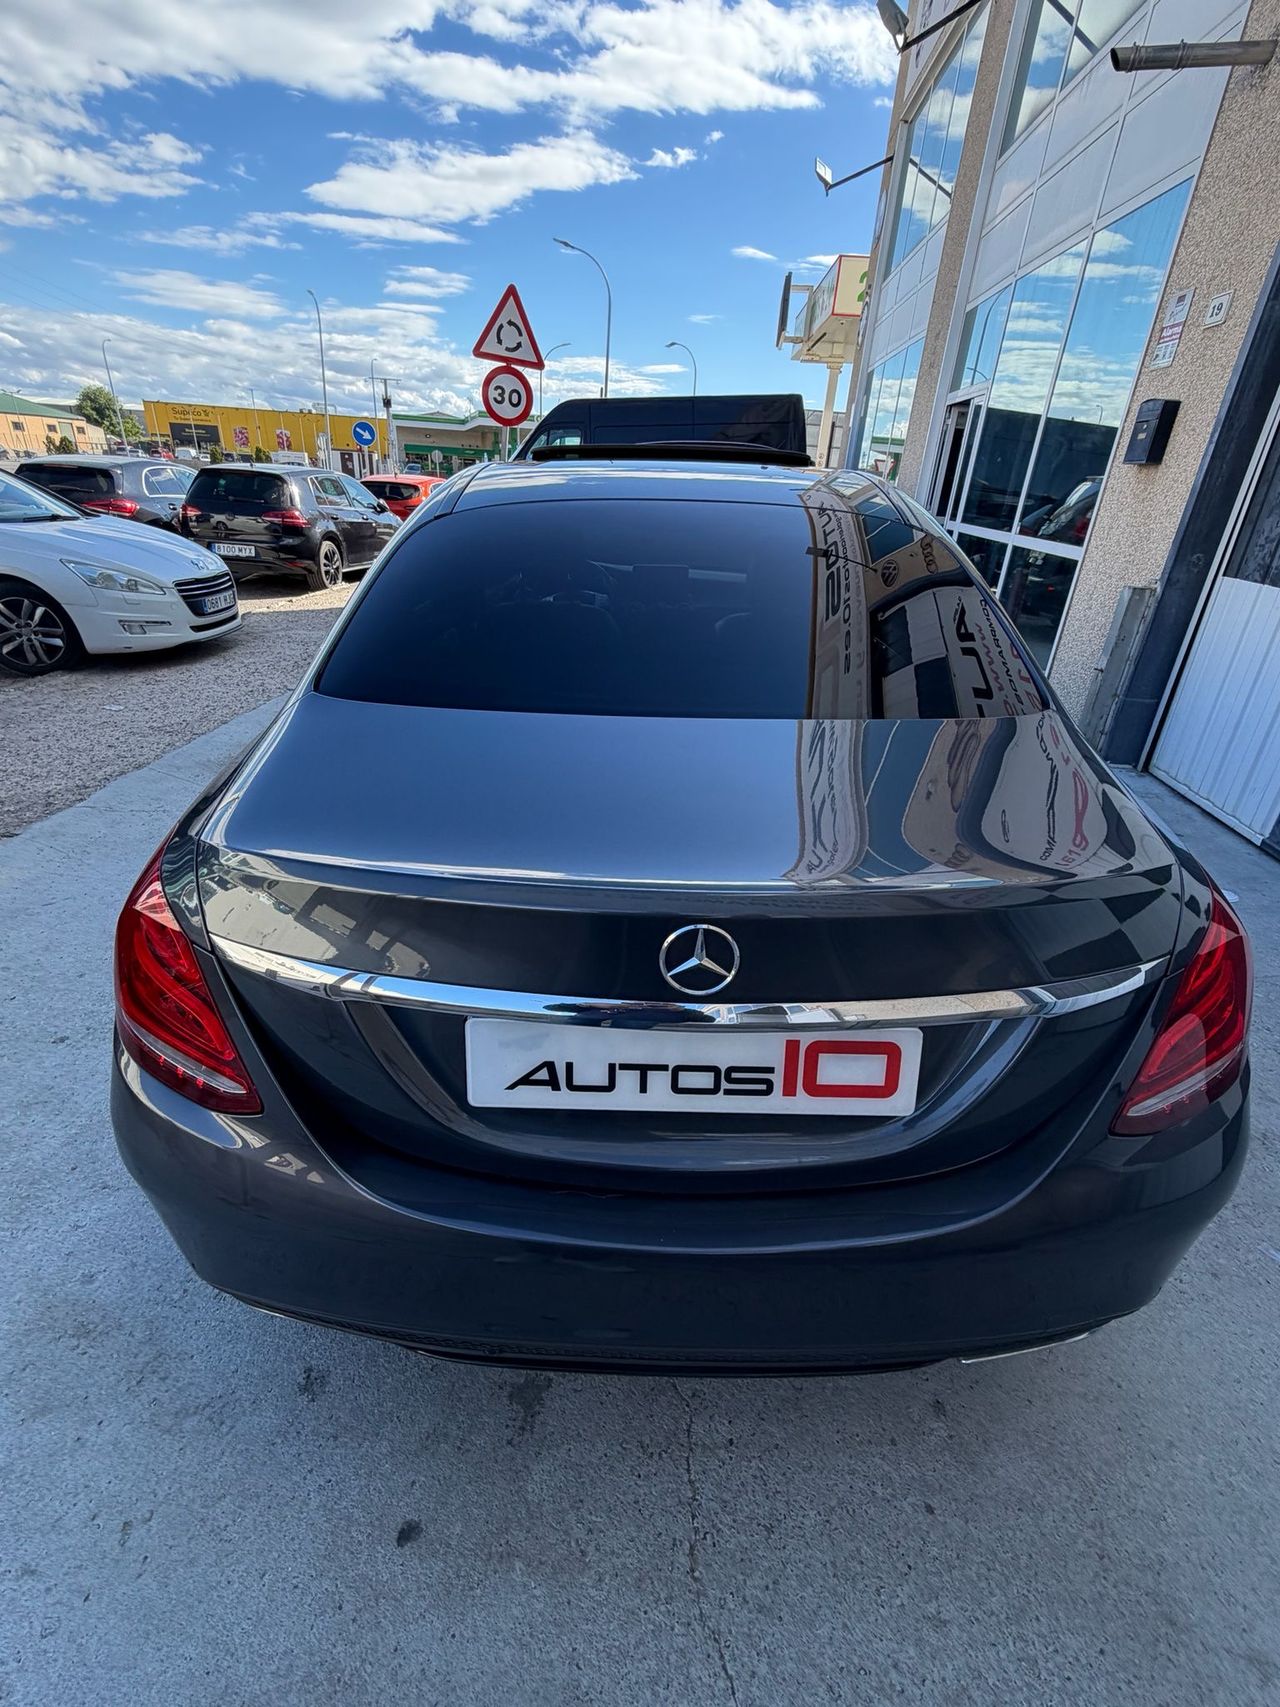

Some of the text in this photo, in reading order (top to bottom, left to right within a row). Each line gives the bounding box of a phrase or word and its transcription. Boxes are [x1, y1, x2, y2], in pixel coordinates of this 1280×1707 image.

[1209, 302, 1223, 319] 19
[493, 385, 522, 408] 30
[217, 545, 236, 554] 8100
[207, 596, 222, 610] 0681
[504, 1039, 902, 1099] AUTOS10
